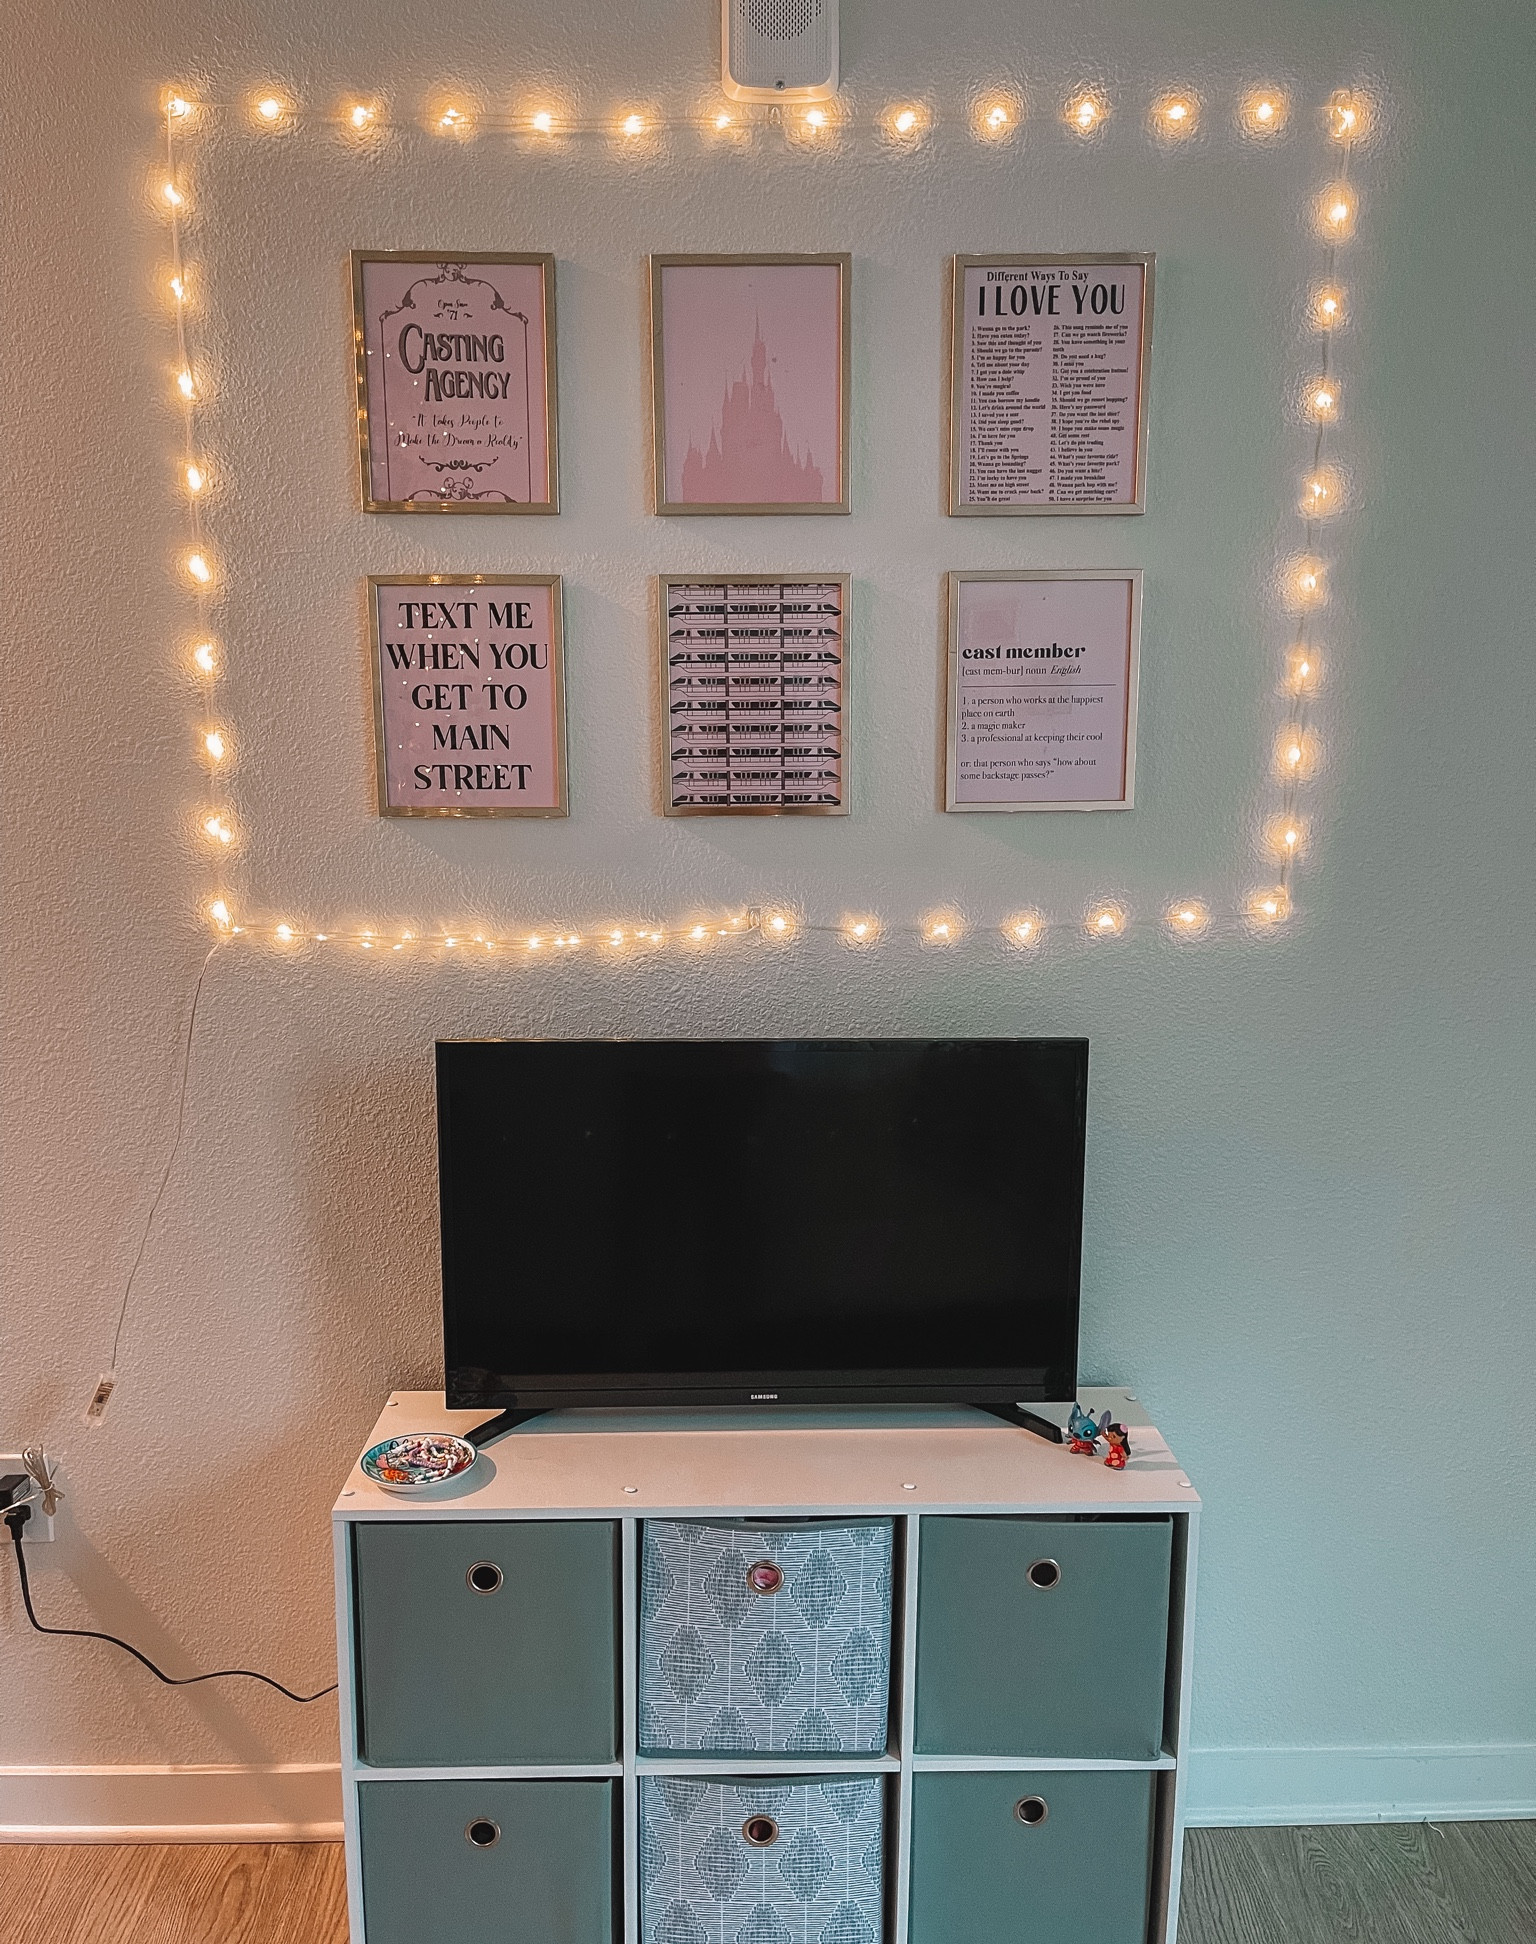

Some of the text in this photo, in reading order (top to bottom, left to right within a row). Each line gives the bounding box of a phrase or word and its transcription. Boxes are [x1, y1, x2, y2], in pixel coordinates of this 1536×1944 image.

[987, 270, 1089, 283] Different Ways To Say
[979, 284, 1125, 316] I LOVE YOU
[398, 602, 533, 629] TEXT ME
[385, 643, 548, 670] WHEN YOU
[962, 642, 1086, 659] cast member
[1050, 665, 1082, 677] English
[411, 684, 528, 710] GET TO
[977, 698, 1004, 707] person
[1006, 696, 1022, 704] who
[1024, 695, 1047, 704] works
[1057, 695, 1070, 704] the
[1071, 695, 1103, 706] happiest
[961, 709, 982, 720] place
[995, 708, 1015, 717] earth
[977, 722, 1000, 732] magic
[1002, 721, 1026, 729] maker
[432, 724, 510, 750] MAIN
[977, 733, 1024, 744] professional
[1034, 733, 1065, 743] keeping
[1067, 732, 1085, 741] their
[1086, 732, 1103, 741] cool
[973, 758, 988, 767] that
[990, 760, 1016, 769] person
[1017, 758, 1034, 767] who
[1035, 760, 1051, 768] says
[1074, 757, 1096, 766] about
[413, 764, 533, 790] STREET
[982, 771, 1020, 781] backstage
